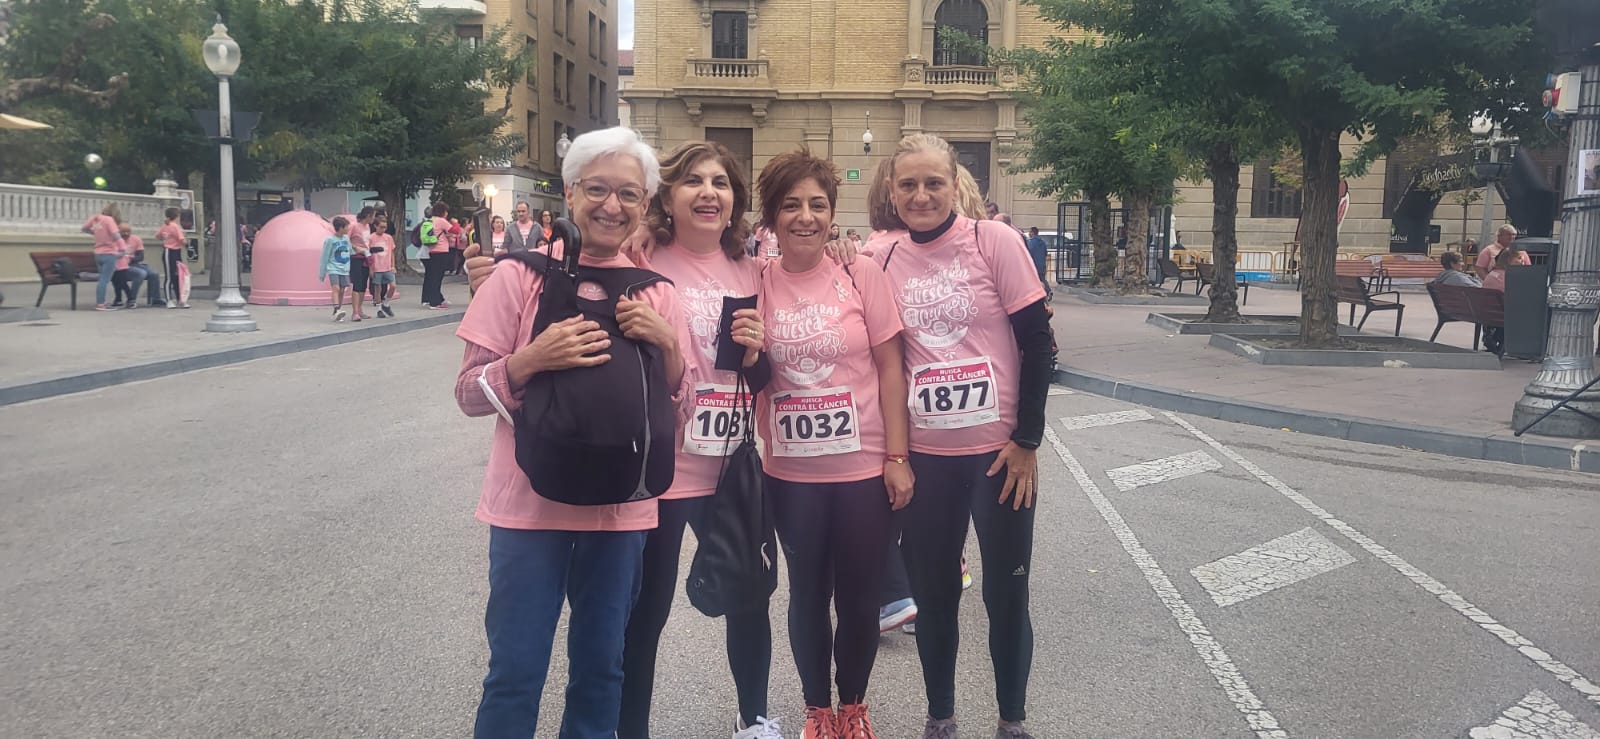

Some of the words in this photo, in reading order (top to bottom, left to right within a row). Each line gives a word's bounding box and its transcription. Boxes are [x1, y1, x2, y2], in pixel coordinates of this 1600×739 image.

[918, 375, 946, 385] CONTRA
[947, 374, 956, 382] EL
[957, 370, 987, 380] CÁNCER
[698, 398, 729, 407] CONTRA
[917, 380, 989, 413] 1877
[778, 403, 807, 411] CONTRA
[818, 399, 849, 409] CÁNCER
[778, 410, 852, 440] 1032
